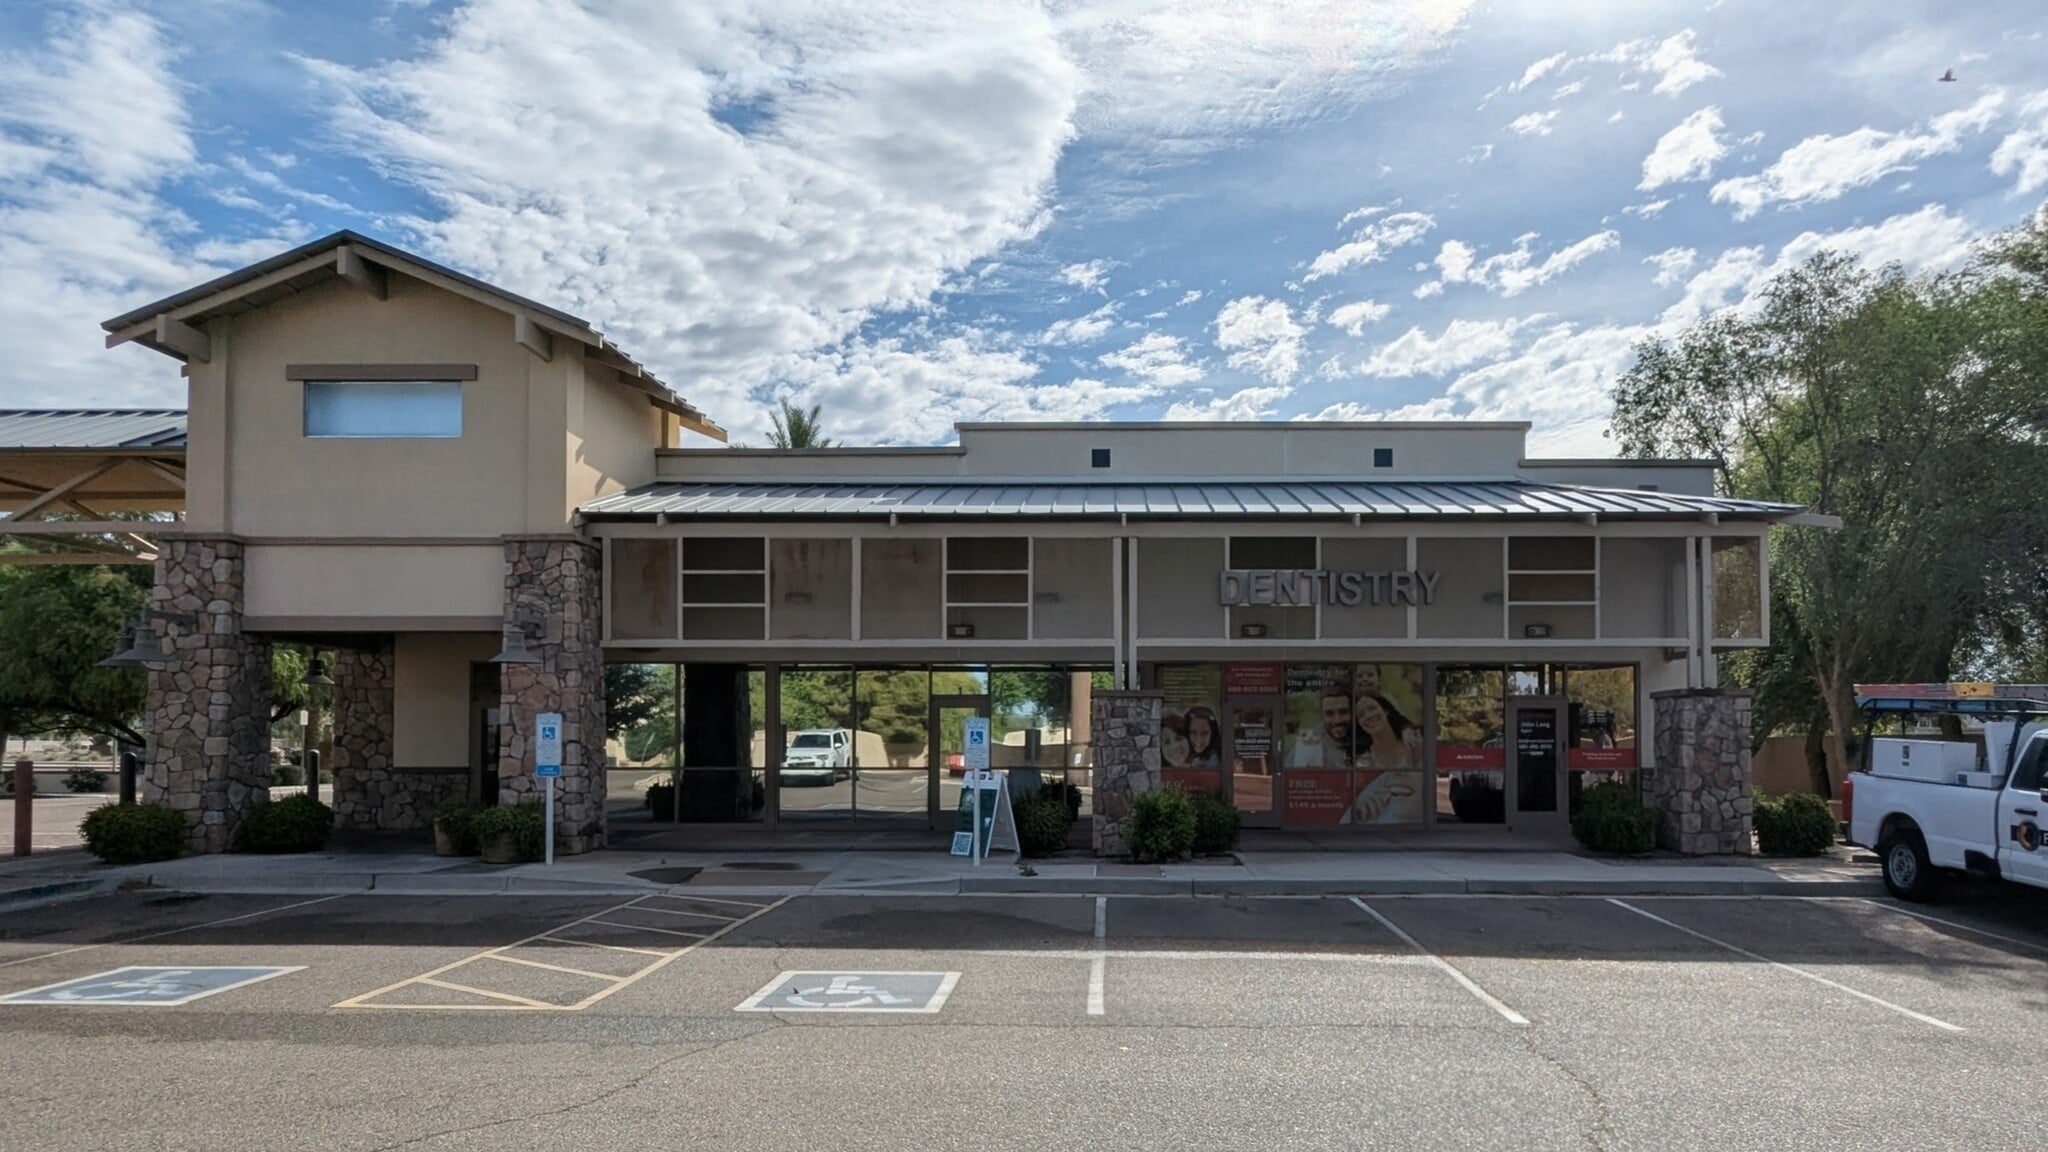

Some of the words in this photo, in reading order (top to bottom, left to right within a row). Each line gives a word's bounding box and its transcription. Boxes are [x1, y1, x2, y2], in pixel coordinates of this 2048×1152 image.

[1220, 570, 1441, 606] DENTISTRY
[1287, 679, 1303, 687] the
[1306, 679, 1335, 687] entire
[1288, 780, 1316, 789] FREE
